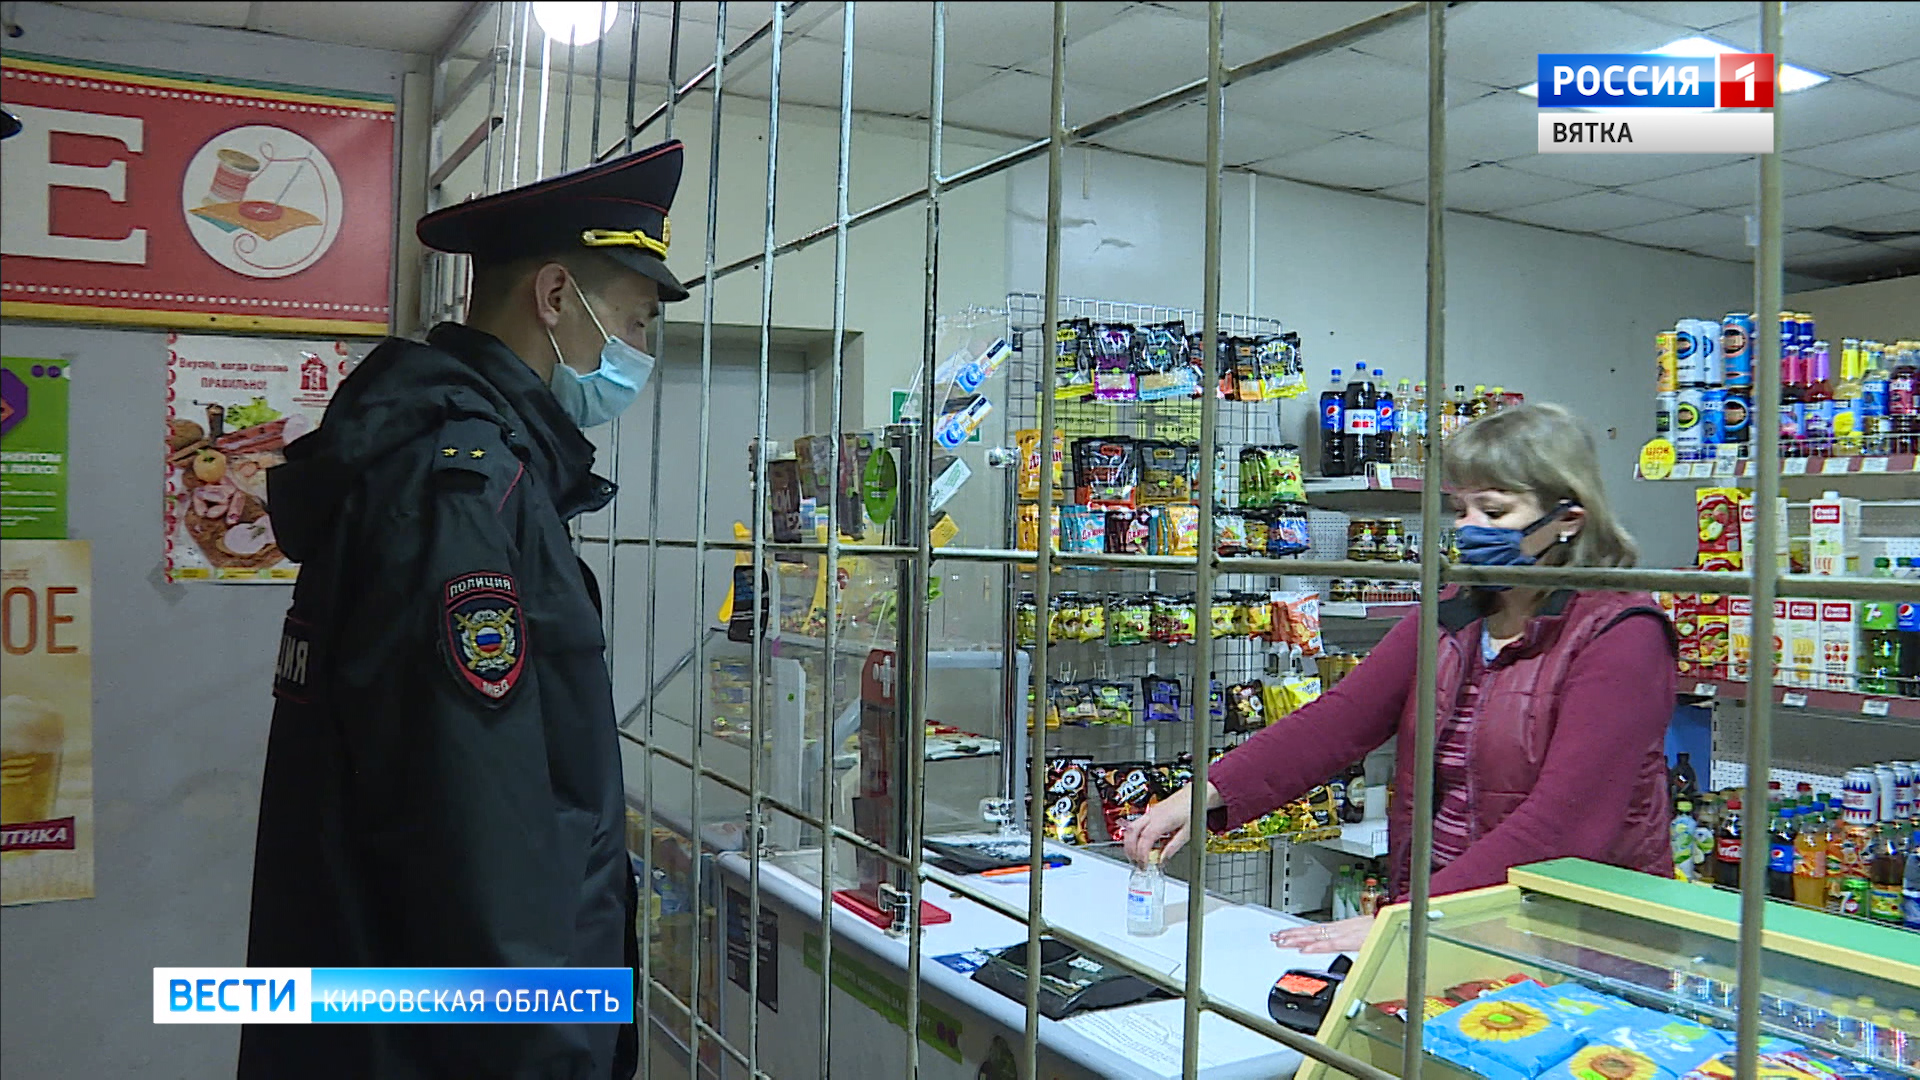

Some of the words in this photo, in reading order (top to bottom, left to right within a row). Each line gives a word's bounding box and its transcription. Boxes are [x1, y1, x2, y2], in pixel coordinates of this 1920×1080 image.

[221, 363, 248, 372] когда
[201, 377, 267, 390] ПРАВИЛЬНО!
[449, 577, 512, 598] ПОЛИЦИЯ
[482, 679, 510, 699] МВД
